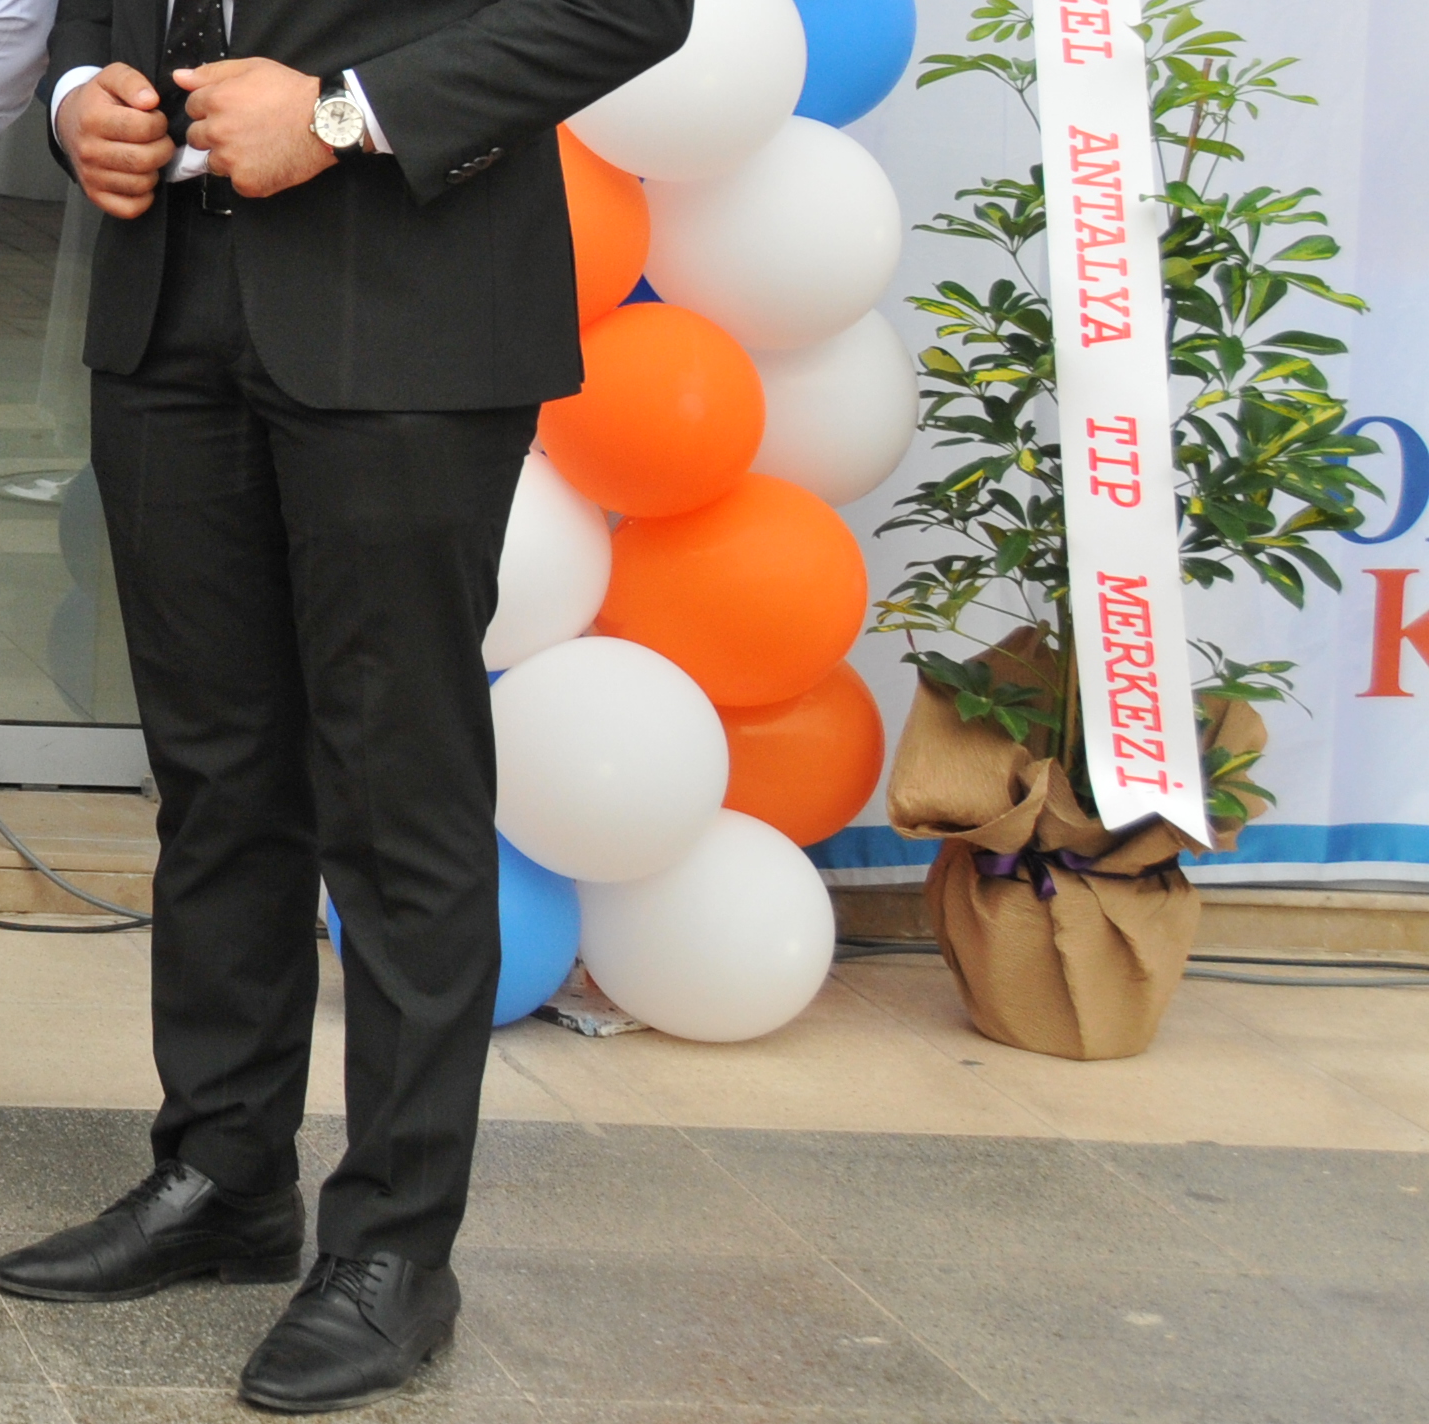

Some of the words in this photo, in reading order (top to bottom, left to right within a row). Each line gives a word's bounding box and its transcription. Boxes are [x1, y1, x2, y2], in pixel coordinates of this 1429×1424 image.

[1067, 125, 1132, 349] ANTALYA
[1085, 414, 1142, 509] TIP
[1096, 570, 1184, 796] MERKEZİ
